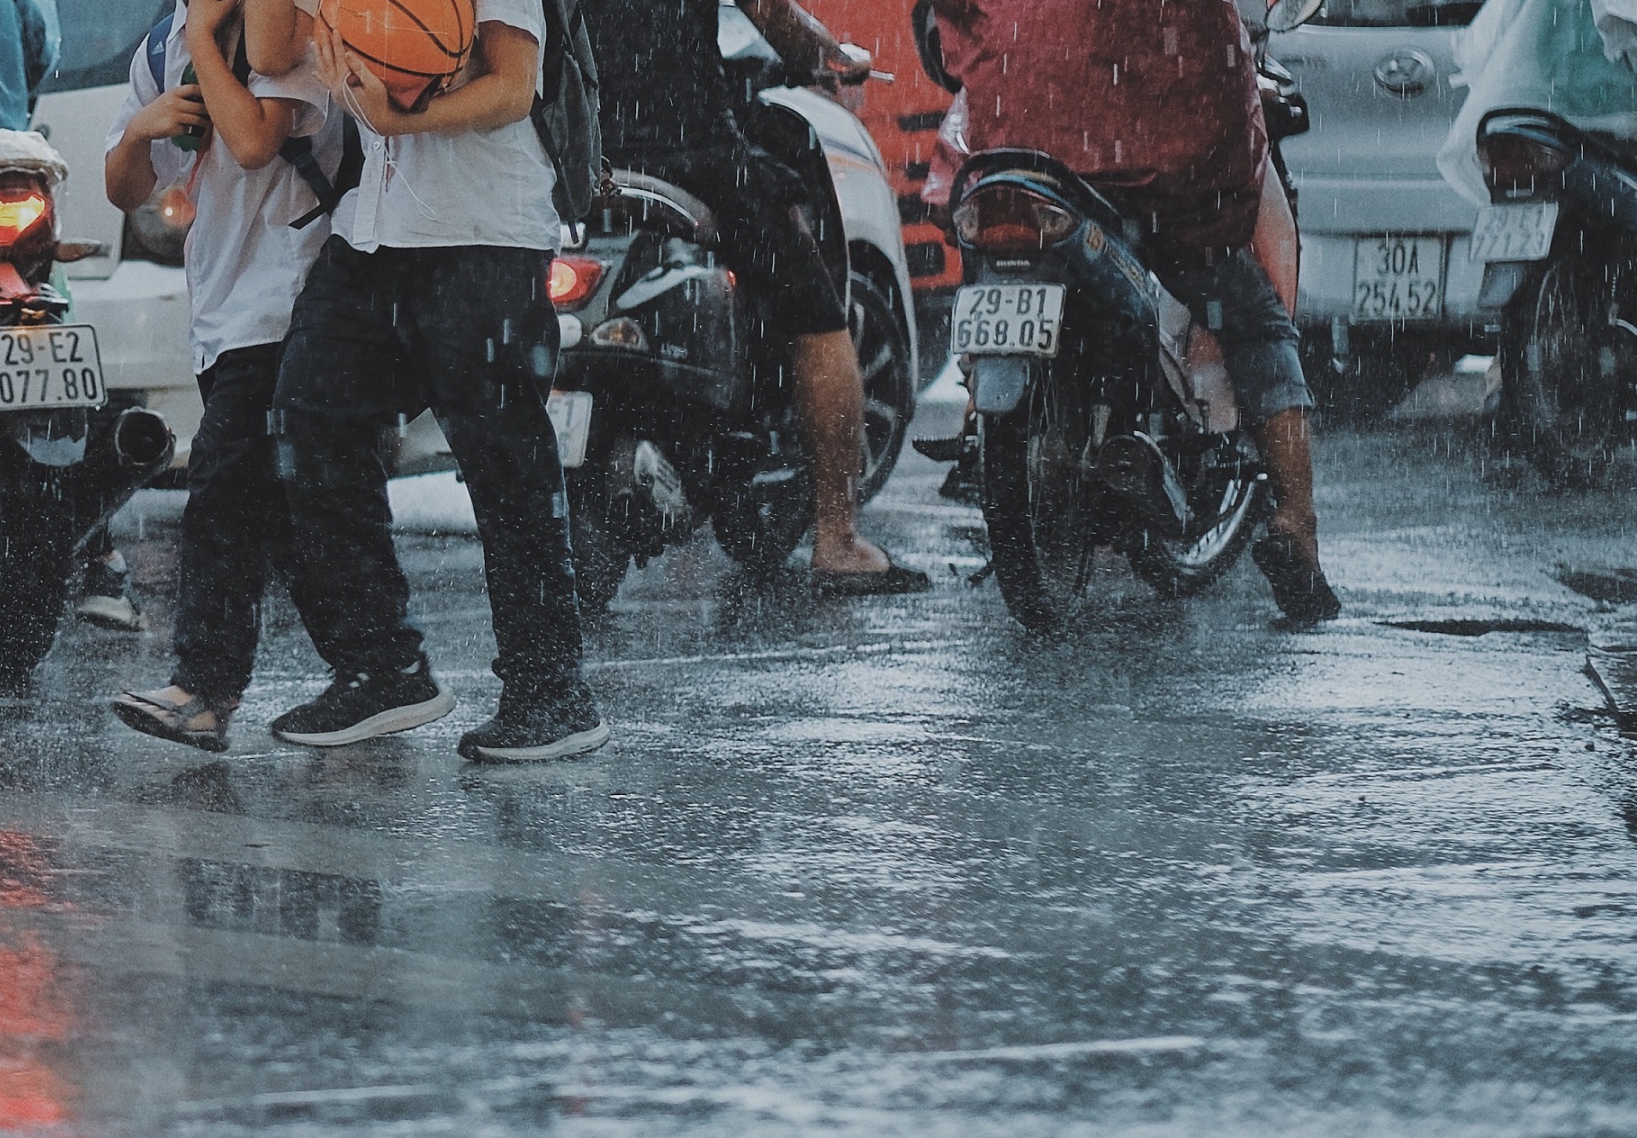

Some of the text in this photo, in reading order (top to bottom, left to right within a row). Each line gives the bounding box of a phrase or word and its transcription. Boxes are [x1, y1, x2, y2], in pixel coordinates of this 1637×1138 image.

[996, 259, 1031, 267] HONDA
[1376, 243, 1420, 275] 30A
[969, 288, 1047, 317] 29-B1
[0, 330, 84, 366] 29-E2
[957, 318, 1053, 350] 668.05
